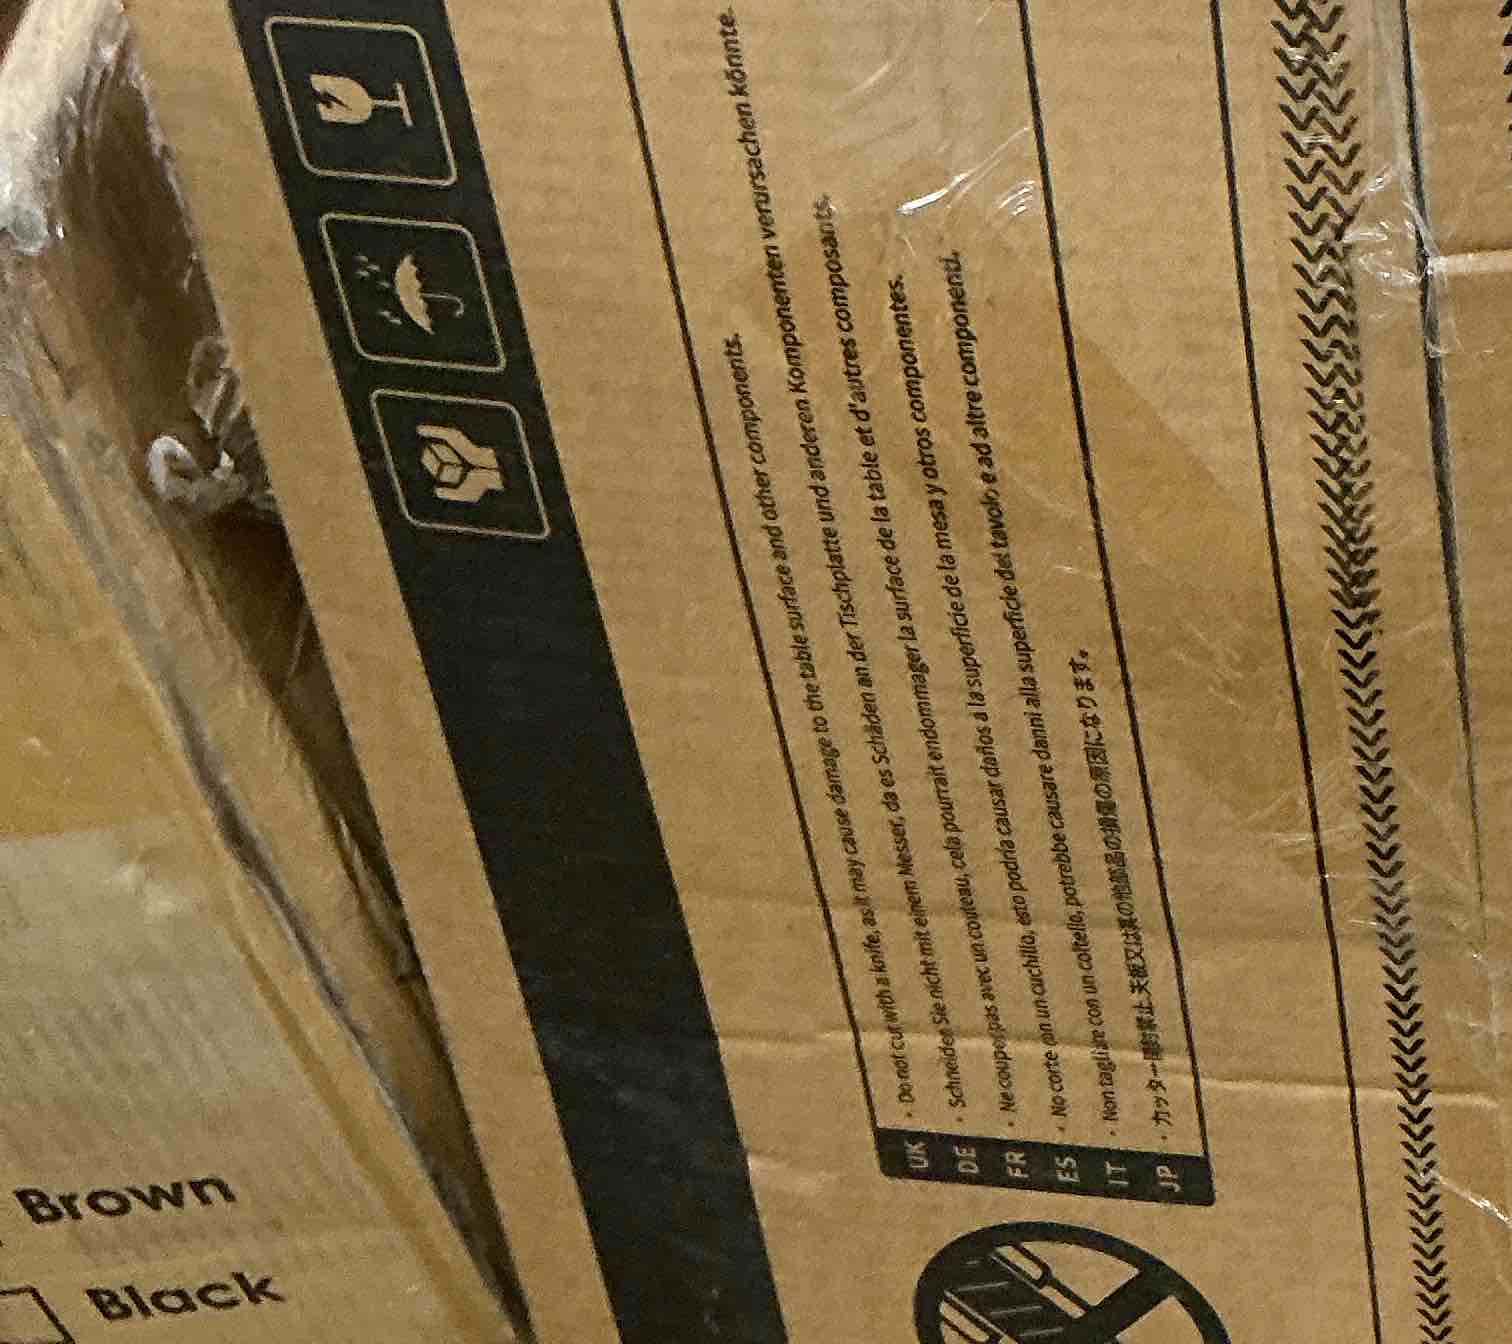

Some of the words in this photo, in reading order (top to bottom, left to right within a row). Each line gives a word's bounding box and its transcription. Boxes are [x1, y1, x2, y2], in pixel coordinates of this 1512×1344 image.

[735, 102, 775, 238] verursachen
[764, 245, 805, 392] Komponenten
[888, 275, 926, 422] componentes.
[724, 333, 765, 463] components.
[840, 338, 870, 421] d'autres
[965, 390, 988, 438] altre
[795, 399, 825, 480] anderen
[914, 427, 938, 479] otros
[753, 467, 778, 520] other
[860, 451, 886, 500] table
[807, 485, 835, 522] und
[928, 499, 951, 549] mesa
[760, 525, 787, 560] and
[775, 565, 804, 630] surface
[822, 527, 857, 627] Tischplatte
[884, 555, 912, 620] surface
[845, 632, 867, 662] der
[947, 601, 981, 686] superficie
[999, 586, 1033, 672] superficie
[791, 634, 816, 679] table
[803, 683, 823, 710] the
[904, 645, 942, 760] endommager
[1018, 676, 1040, 708] alla
[860, 692, 889, 764] Schäden
[975, 726, 1000, 777] daños
[1023, 711, 1050, 760] danni
[818, 737, 845, 804] damage
[927, 765, 959, 832] pourrait
[987, 781, 1012, 835] causar
[1038, 764, 1064, 829] causare
[834, 807, 858, 854] cause
[888, 816, 913, 875] Messer,
[942, 836, 966, 869] cela
[847, 860, 865, 892] may
[996, 839, 1026, 891] podría
[1050, 832, 1080, 906] potrebbe
[904, 880, 927, 927] einem
[1012, 895, 1031, 926] esto
[862, 930, 886, 972] knife,
[913, 930, 933, 956] mit
[919, 960, 943, 999] nicht
[975, 966, 995, 1001] avec
[875, 989, 897, 1022] with
[930, 1002, 949, 1024] Sie
[984, 1004, 1005, 1030] pas
[889, 1053, 909, 1080] not
[1101, 1090, 1118, 1120] Non
[902, 1139, 933, 1169] UK
[952, 1144, 982, 1174] DE
[1002, 1149, 1031, 1178] FR
[1052, 1154, 1082, 1183] ES
[1102, 1159, 1130, 1185] IT
[1154, 1163, 1183, 1192] JP
[14, 1174, 237, 1225] Brown
[86, 1270, 286, 1321] Black
